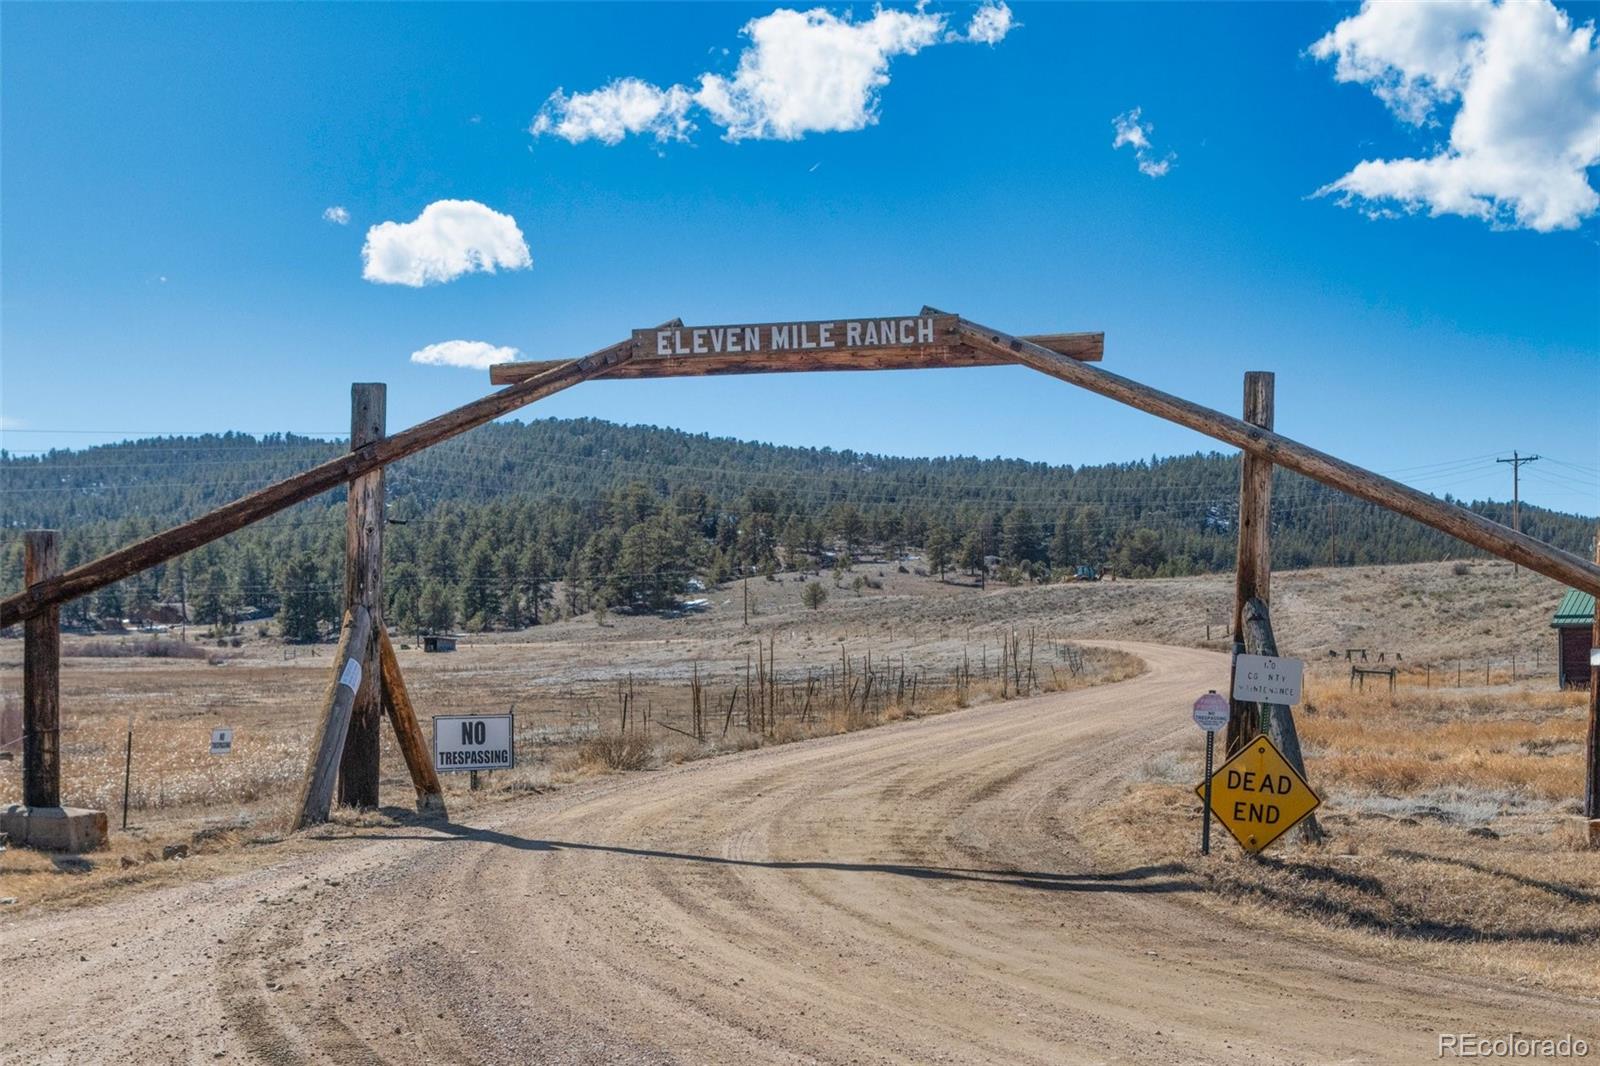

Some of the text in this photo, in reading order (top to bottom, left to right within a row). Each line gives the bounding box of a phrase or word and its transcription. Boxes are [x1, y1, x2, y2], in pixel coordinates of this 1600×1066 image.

[657, 318, 934, 355] ELEVEN MILE RANCH
[462, 721, 486, 745] NO
[439, 749, 508, 765] TRESPASSING
[1228, 770, 1292, 795] DEAD
[1234, 801, 1280, 824] END
